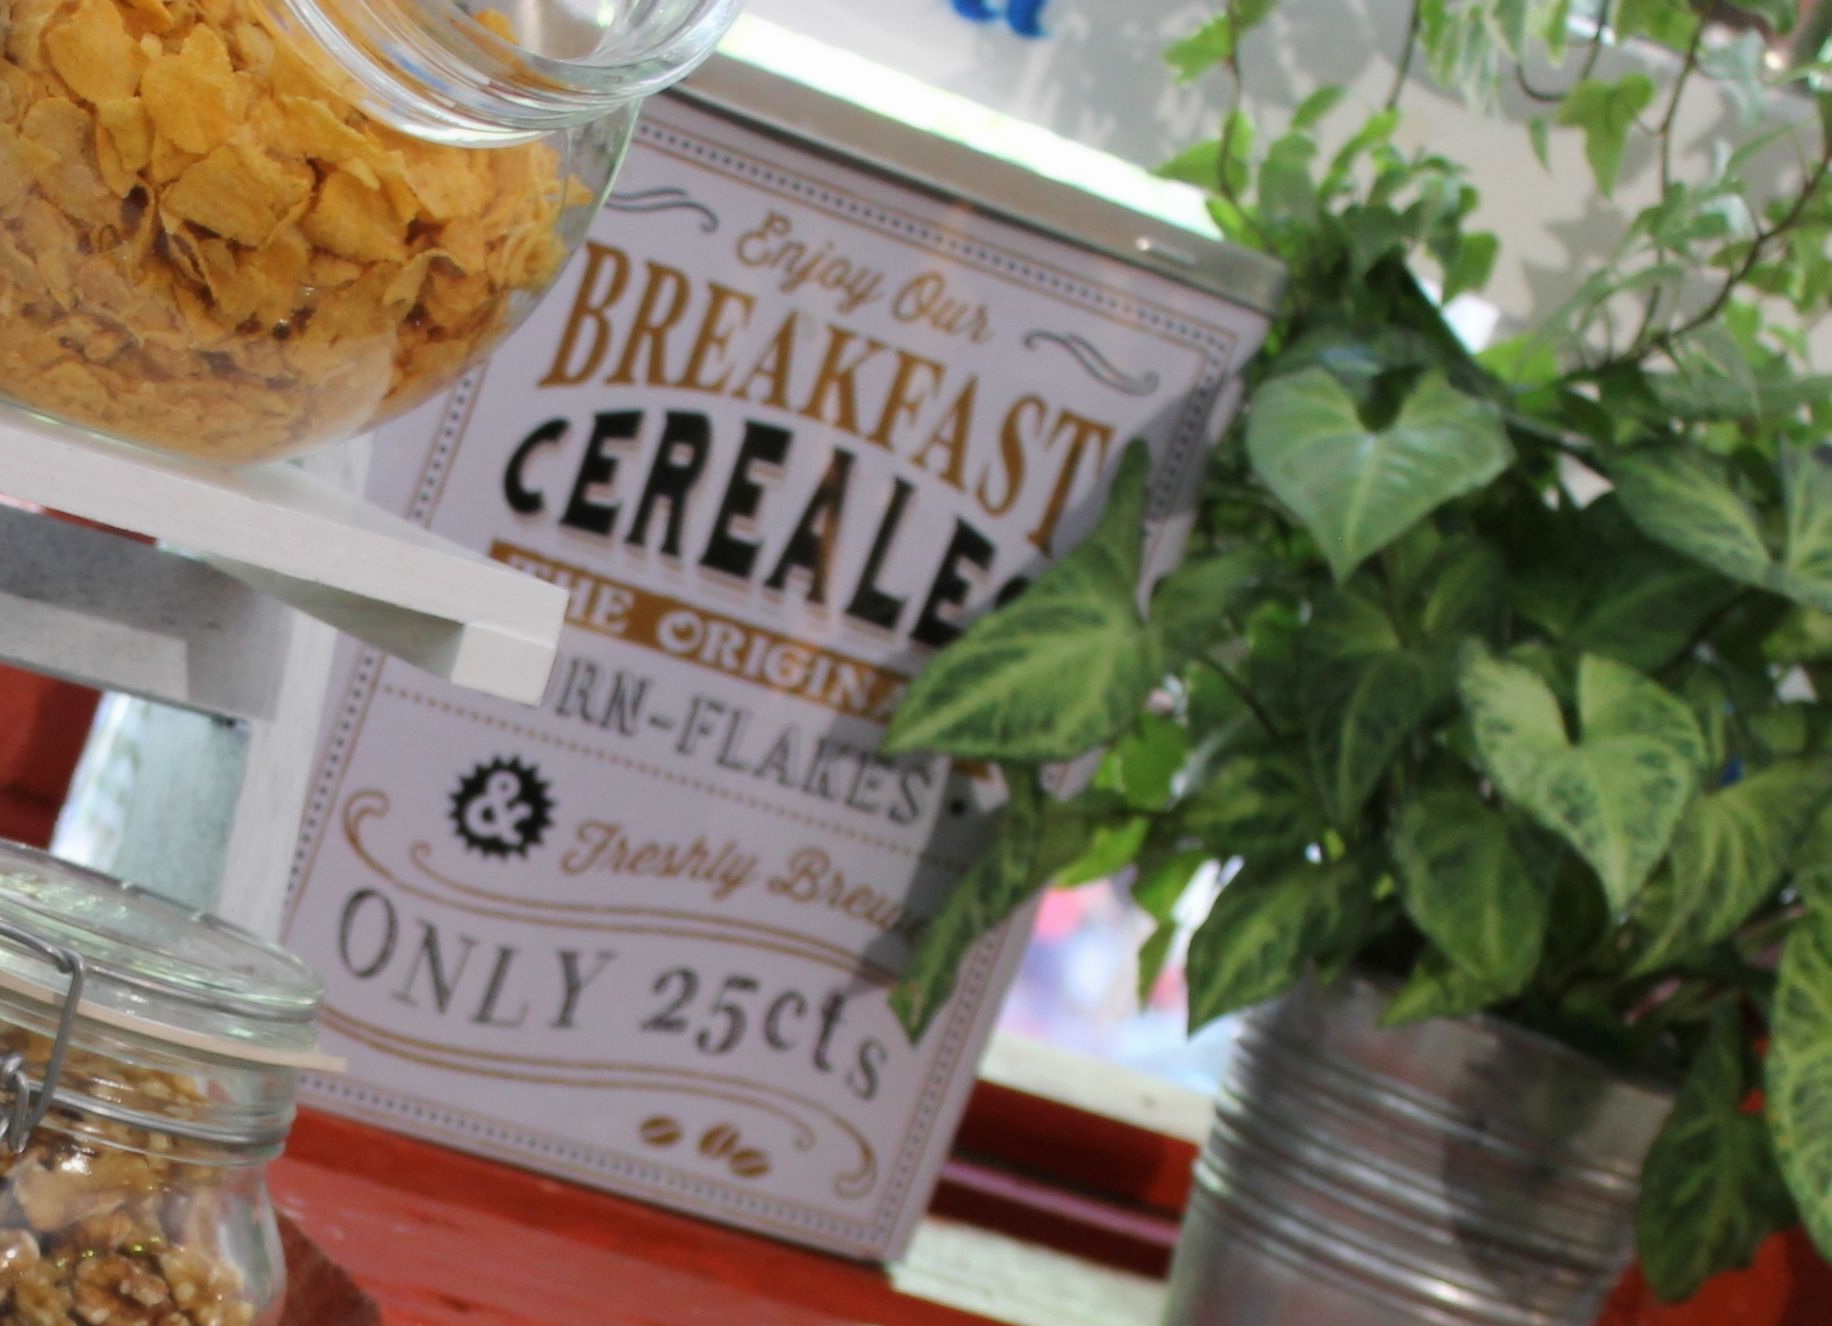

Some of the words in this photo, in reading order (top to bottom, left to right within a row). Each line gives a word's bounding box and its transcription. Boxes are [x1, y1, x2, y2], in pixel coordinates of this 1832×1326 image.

[735, 210, 883, 308] Enjoy
[892, 268, 998, 346] Our
[536, 240, 1116, 557] BREAKFAST
[501, 408, 1030, 648] CEREALE
[465, 771, 538, 846] &
[554, 654, 935, 827] RN-FLAKES
[561, 820, 758, 900] Freshly
[337, 887, 618, 1031] ONLY
[640, 966, 890, 1102] 25cts
